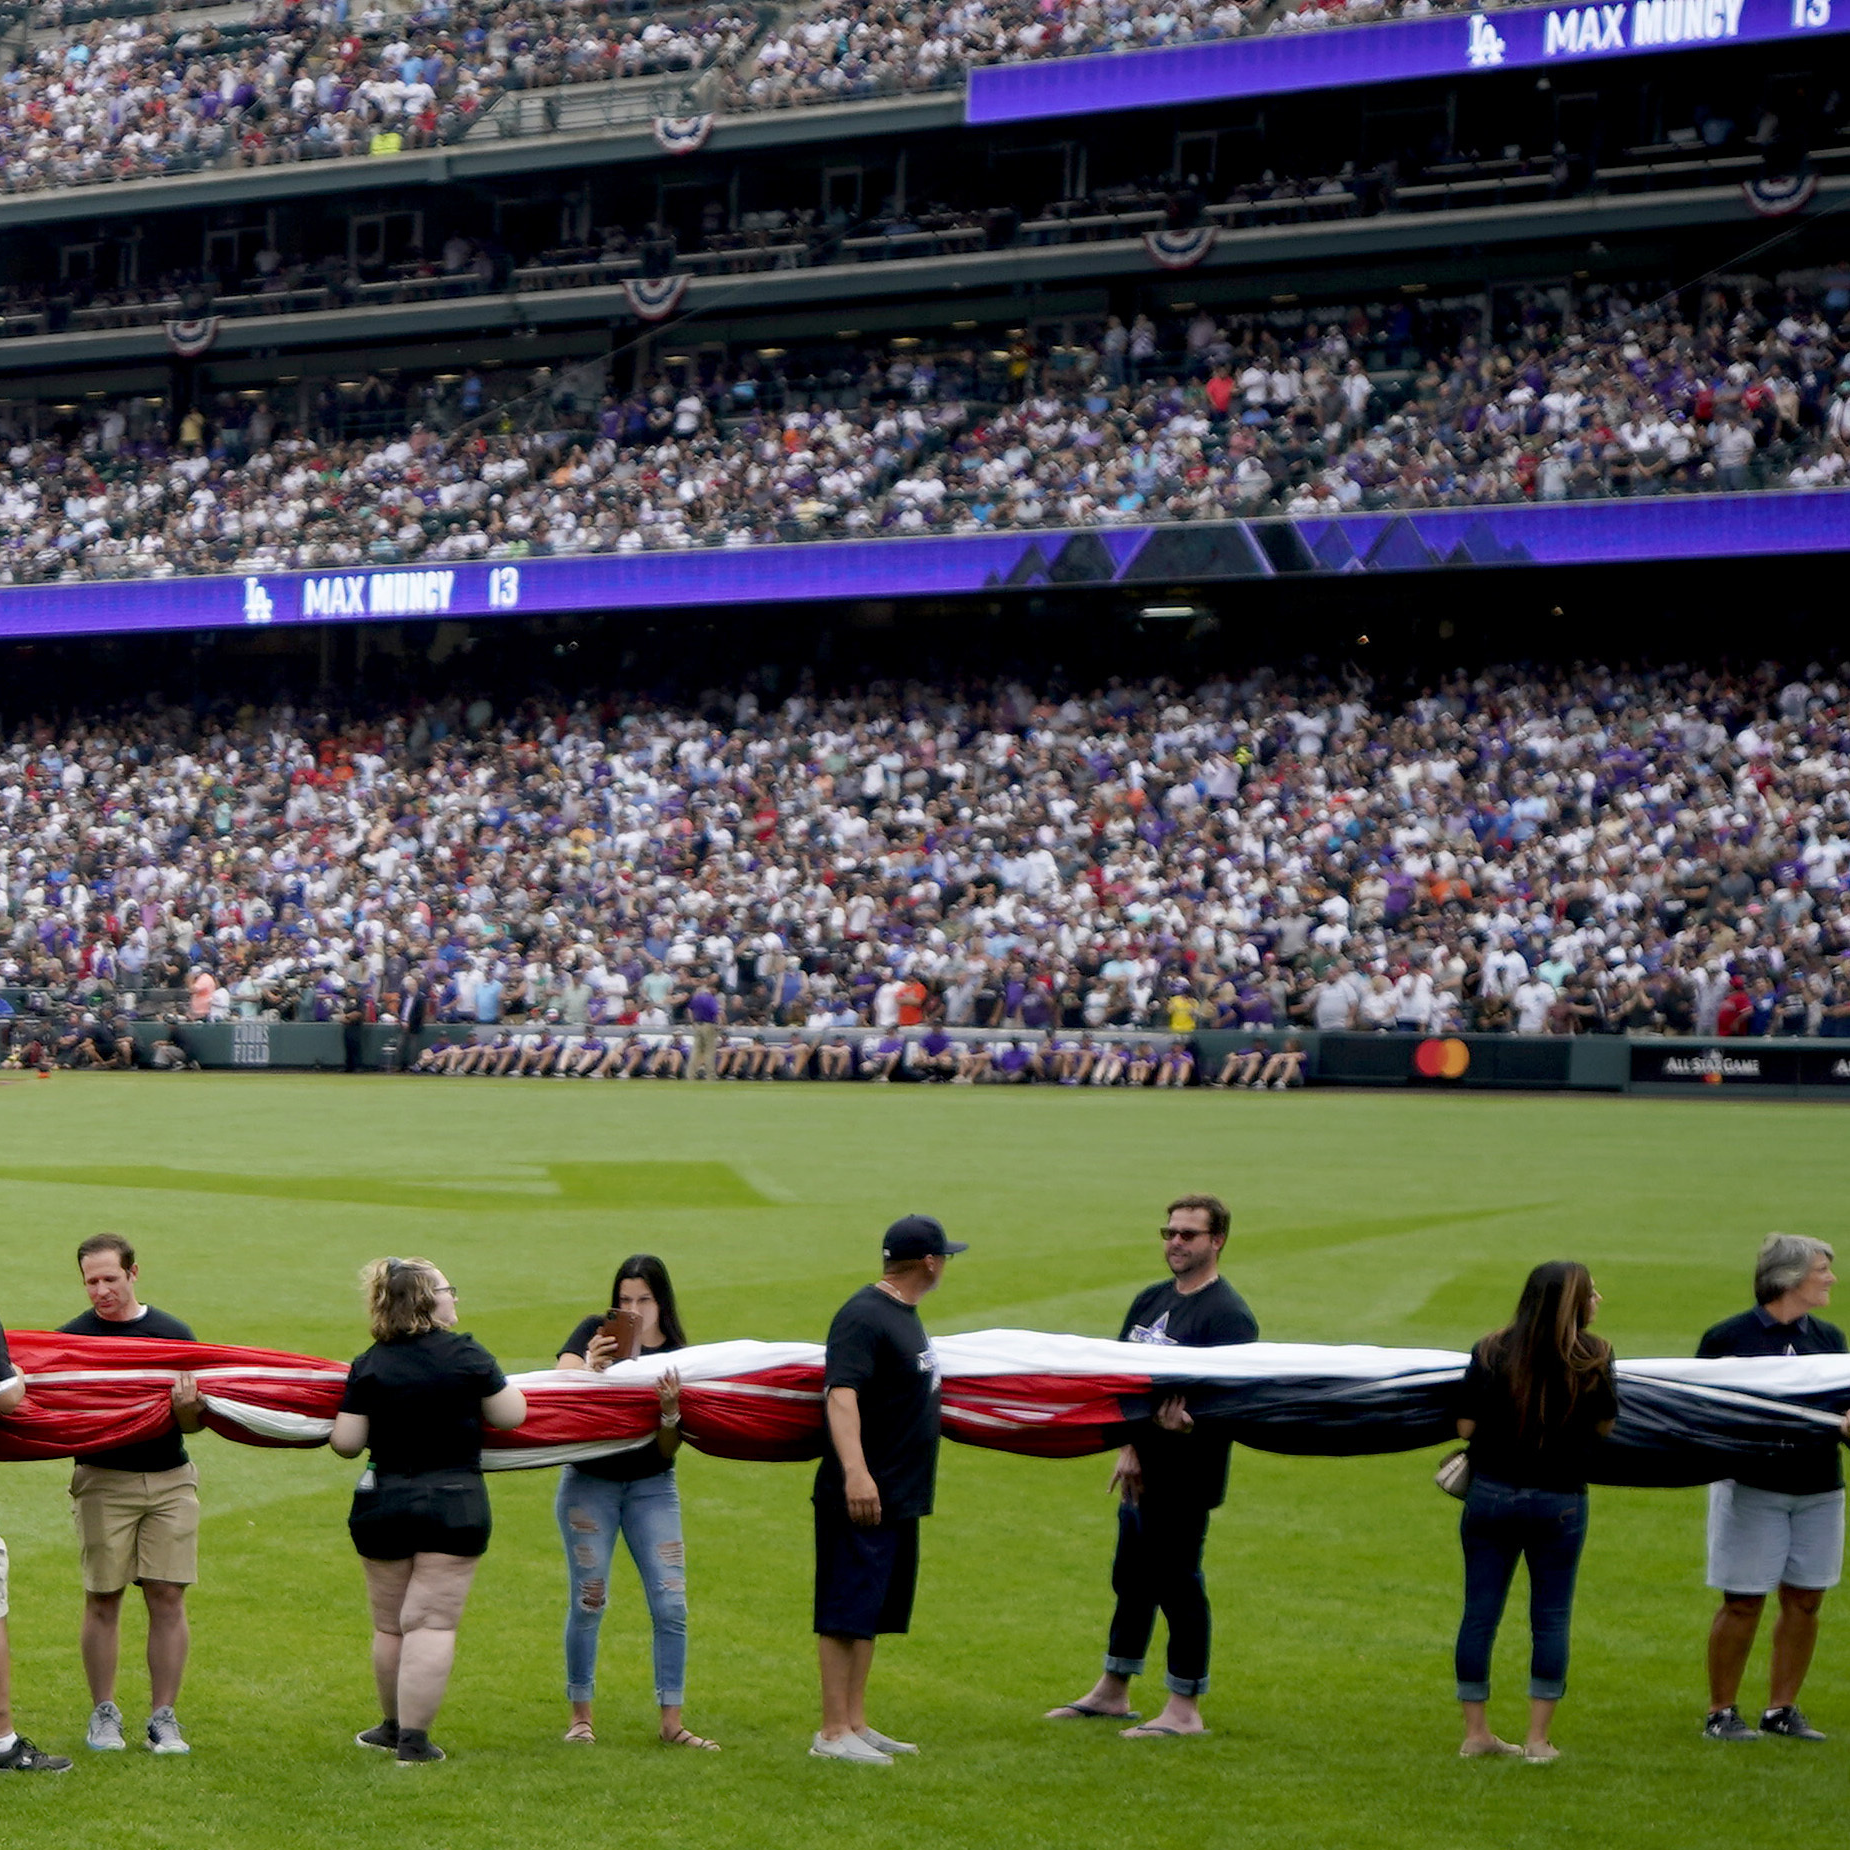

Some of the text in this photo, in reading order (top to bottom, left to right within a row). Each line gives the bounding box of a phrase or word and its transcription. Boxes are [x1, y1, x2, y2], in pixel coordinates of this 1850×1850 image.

[1543, 0, 1831, 56] MAX MUNCY 13
[302, 566, 519, 616] MAX MUNCY 13
[233, 1044, 270, 1064] FIELD
